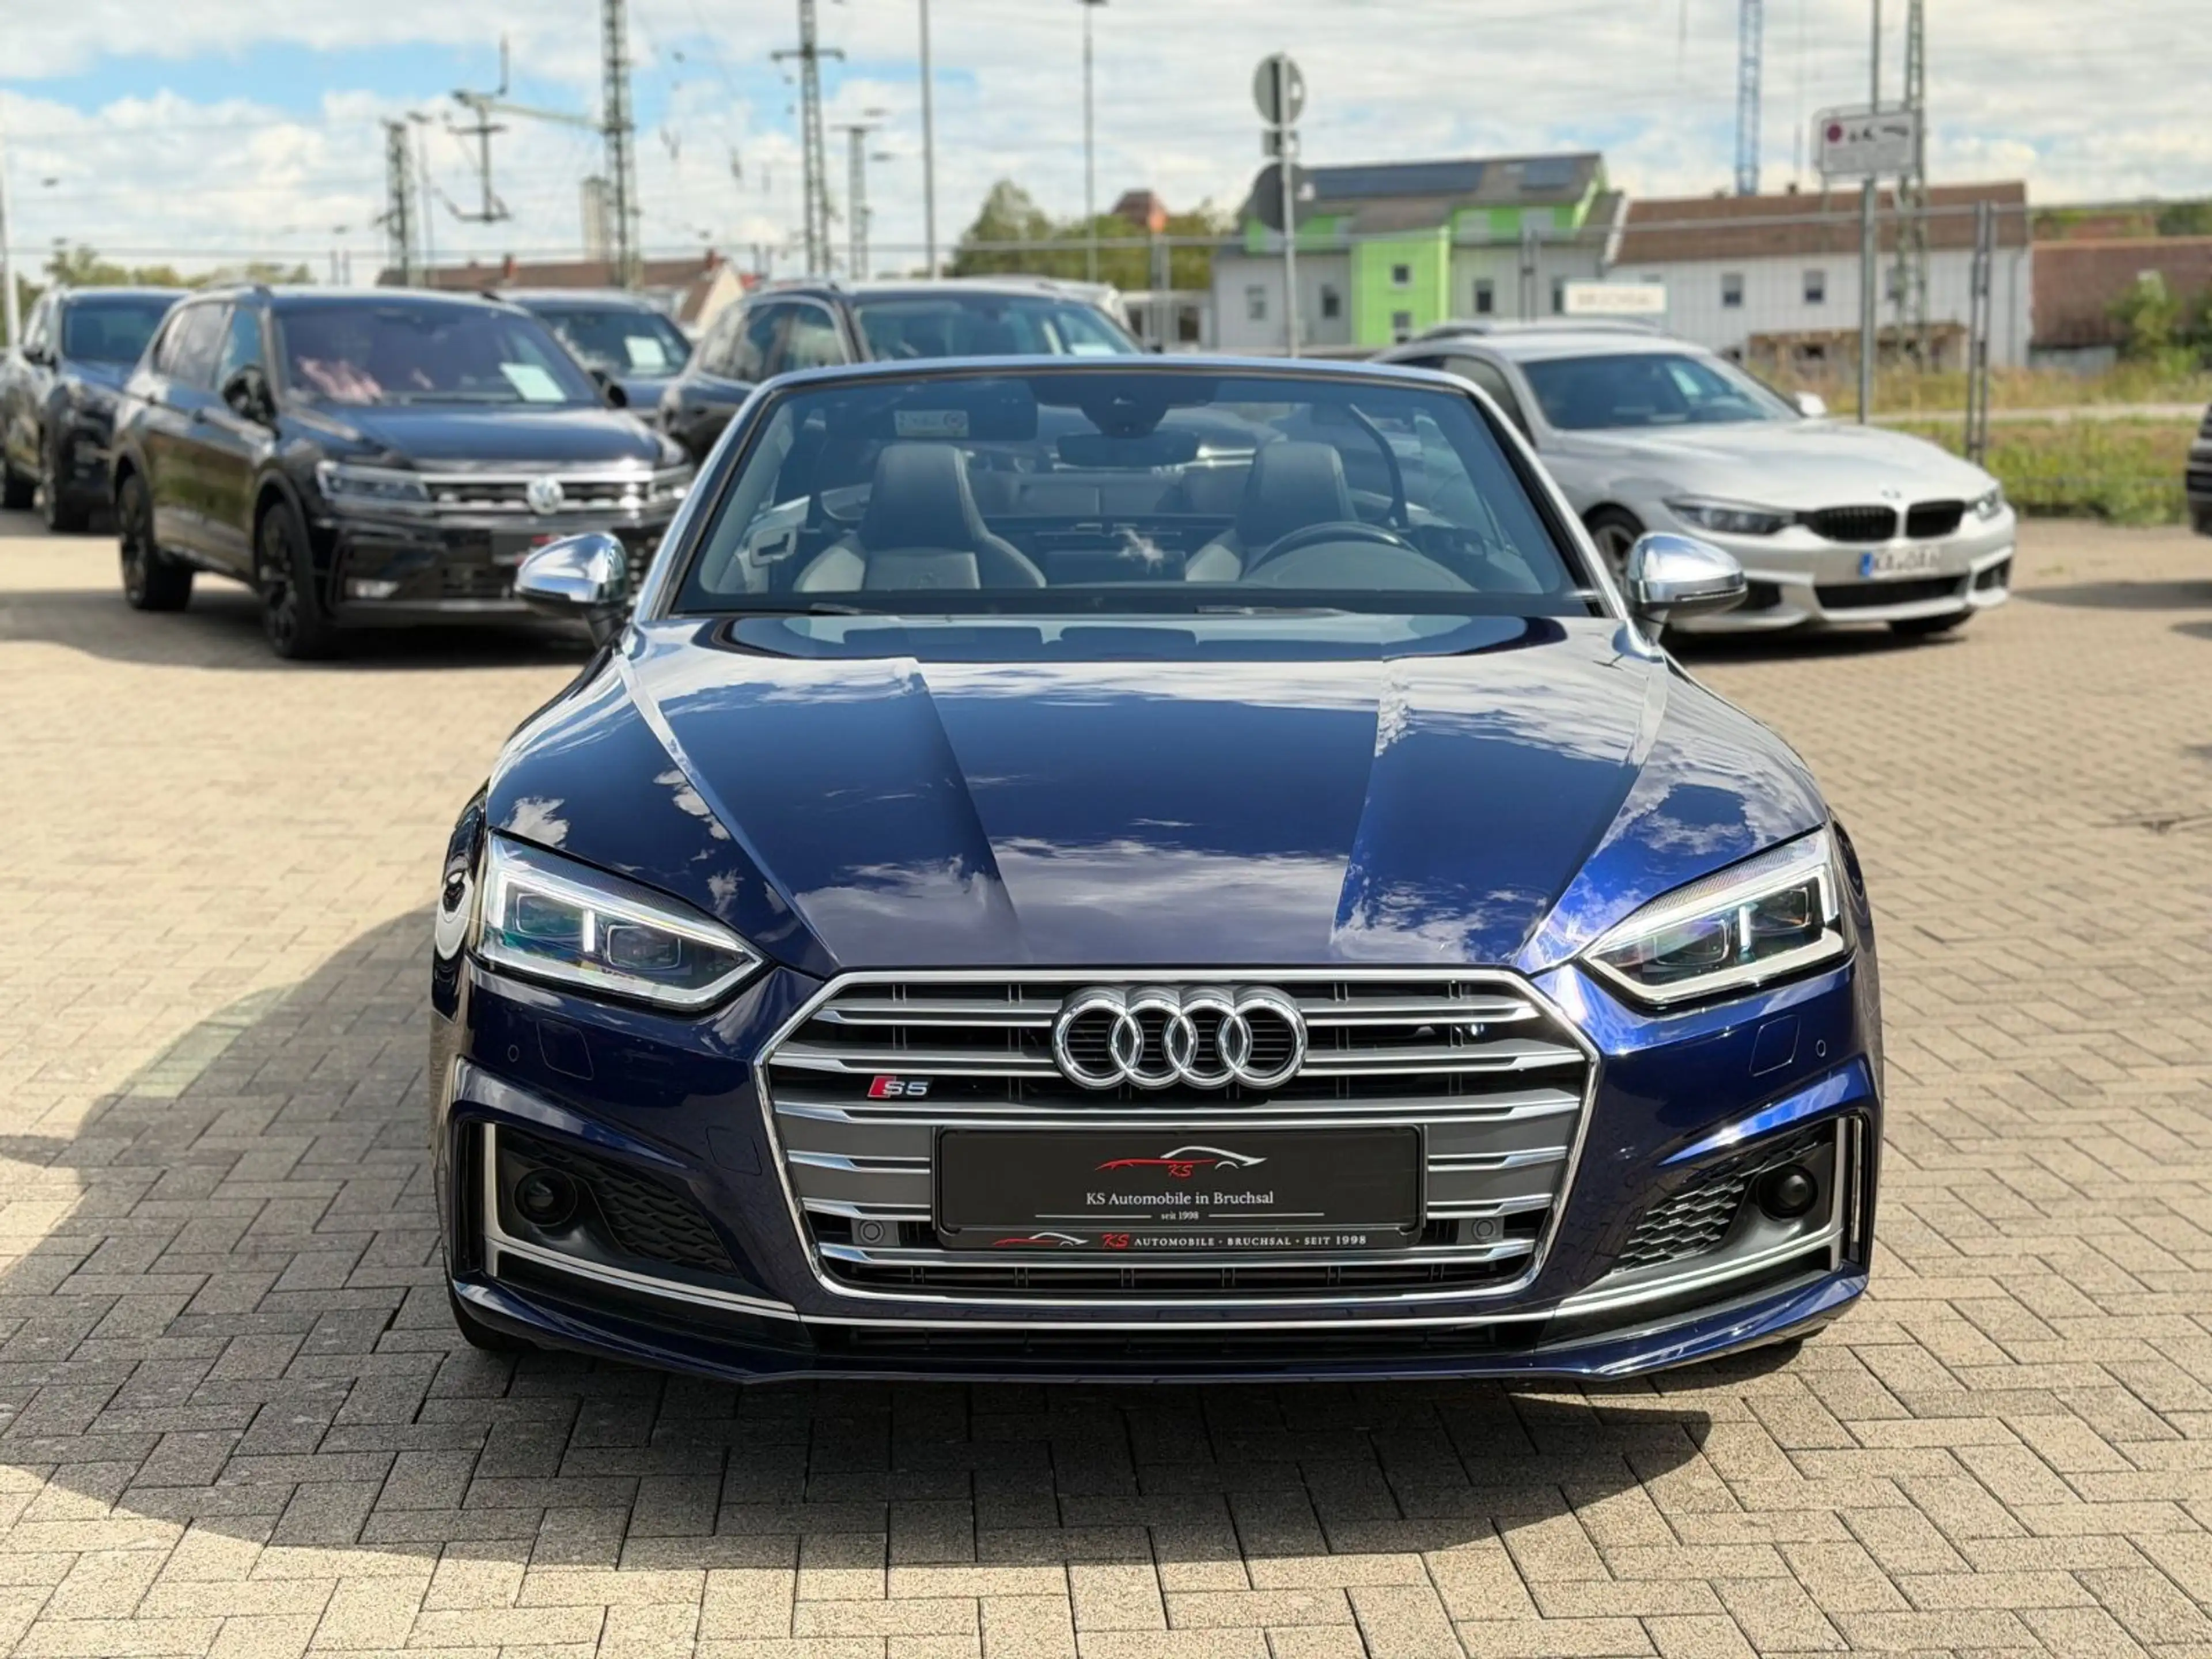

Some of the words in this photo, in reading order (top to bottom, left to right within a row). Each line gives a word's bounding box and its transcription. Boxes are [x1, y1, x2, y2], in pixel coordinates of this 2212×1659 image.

[882, 1081, 929, 1096] S5
[1168, 1164, 1193, 1177] KS
[1086, 1192, 1105, 1205] KS
[1109, 1192, 1191, 1205] Automobile
[1195, 1192, 1209, 1205] in
[1214, 1191, 1274, 1205] Bruchsal
[1161, 1211, 1176, 1220] seit
[1179, 1211, 1199, 1219] 1998
[1101, 1233, 1130, 1249] KS
[1134, 1237, 1215, 1247] AUTOMOBILE
[1227, 1237, 1292, 1246] BRUCHSAL
[1304, 1237, 1331, 1245] SEIT
[1336, 1235, 1367, 1245] 1998
